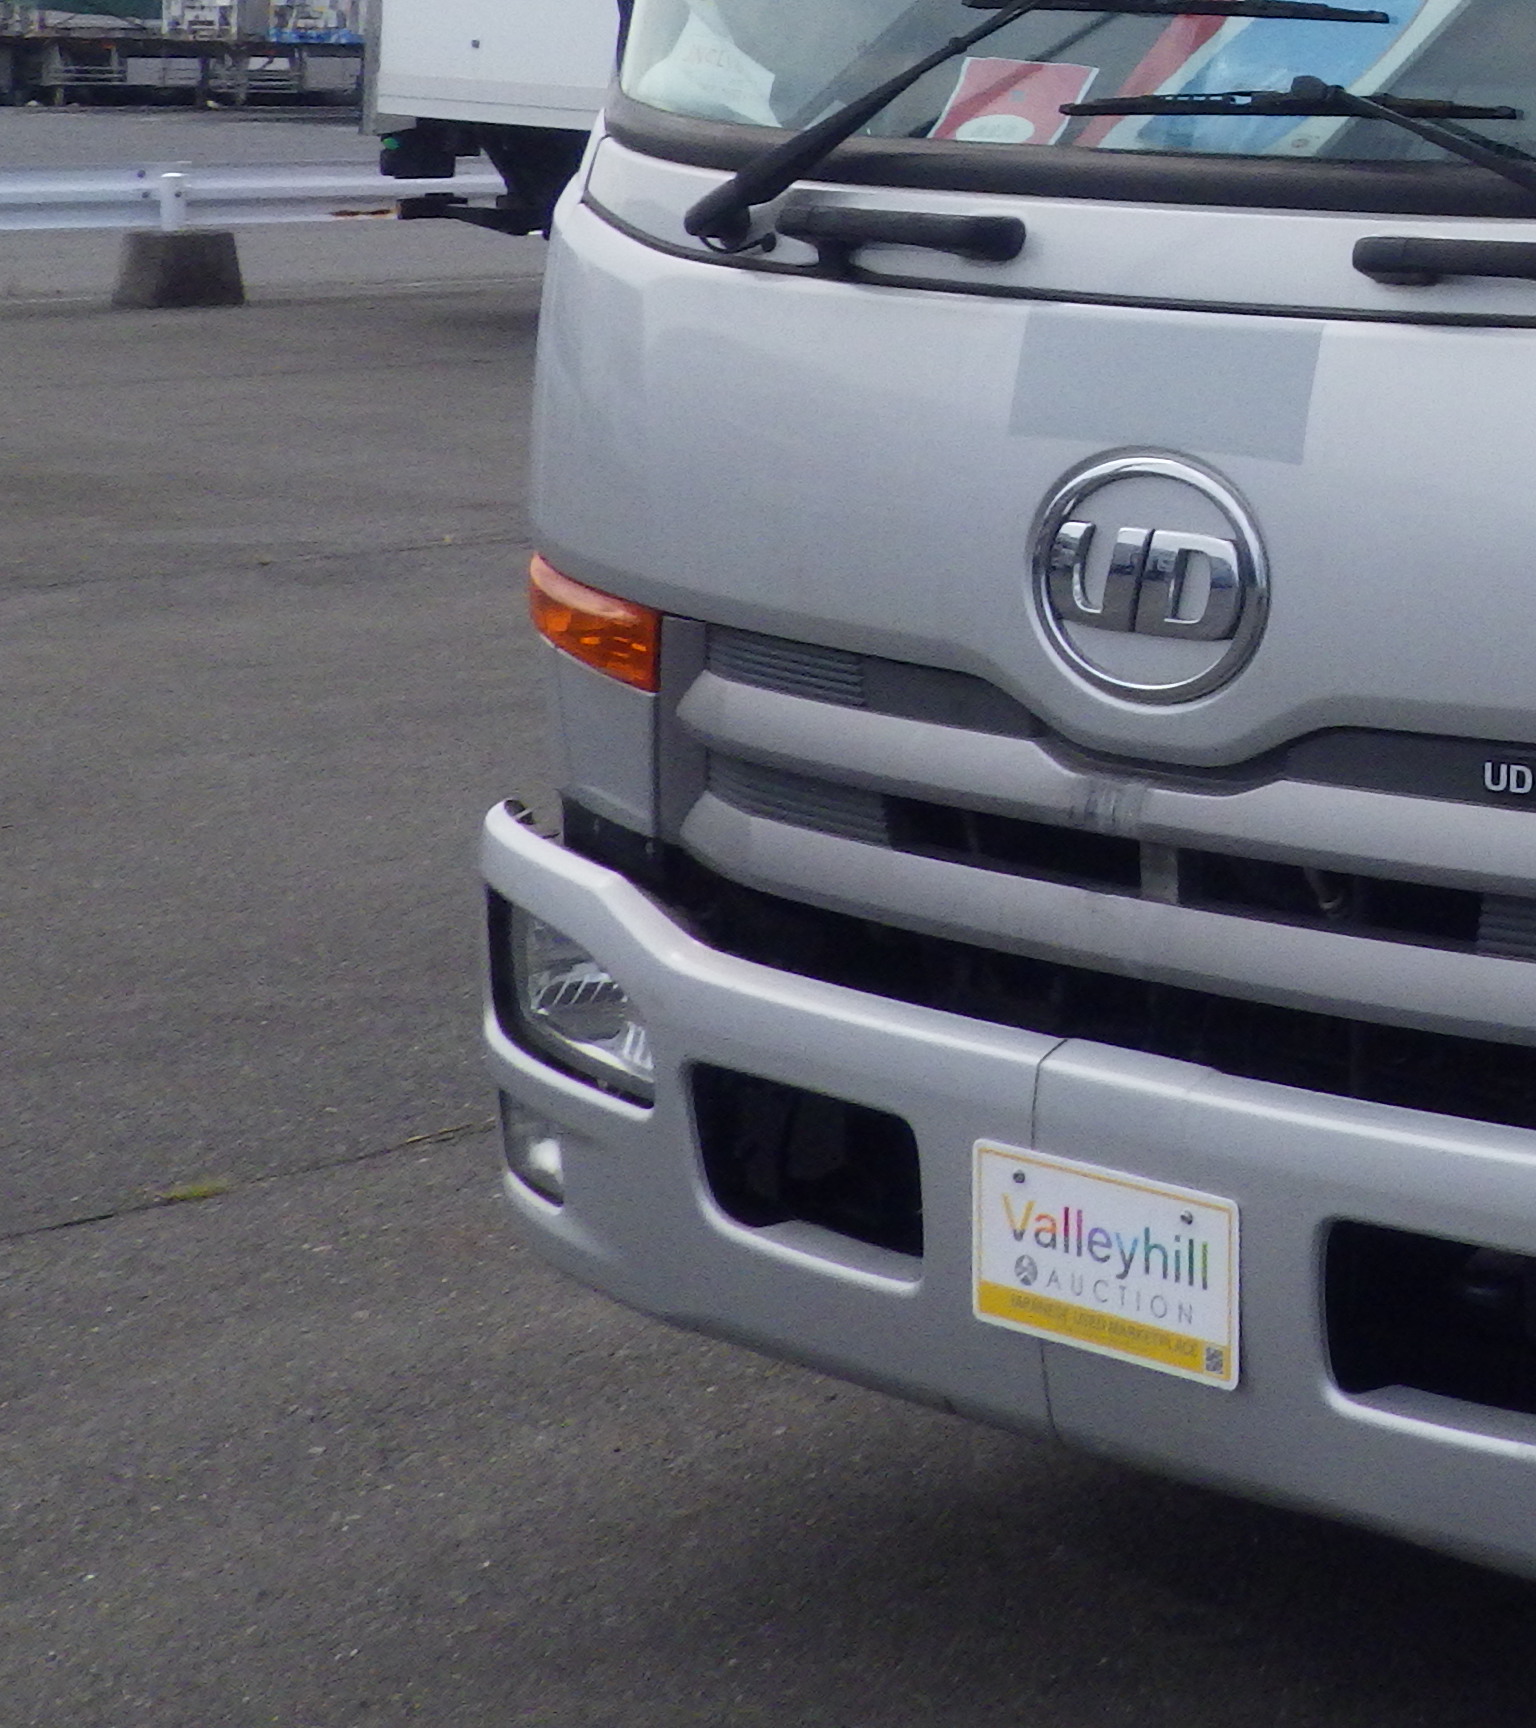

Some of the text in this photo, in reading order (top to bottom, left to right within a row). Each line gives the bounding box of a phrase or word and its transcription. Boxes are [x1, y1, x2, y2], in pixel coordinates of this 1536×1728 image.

[1484, 760, 1533, 795] UD
[1002, 1192, 1209, 1290] Valleyhill
[1046, 1268, 1194, 1325] AUCTION
